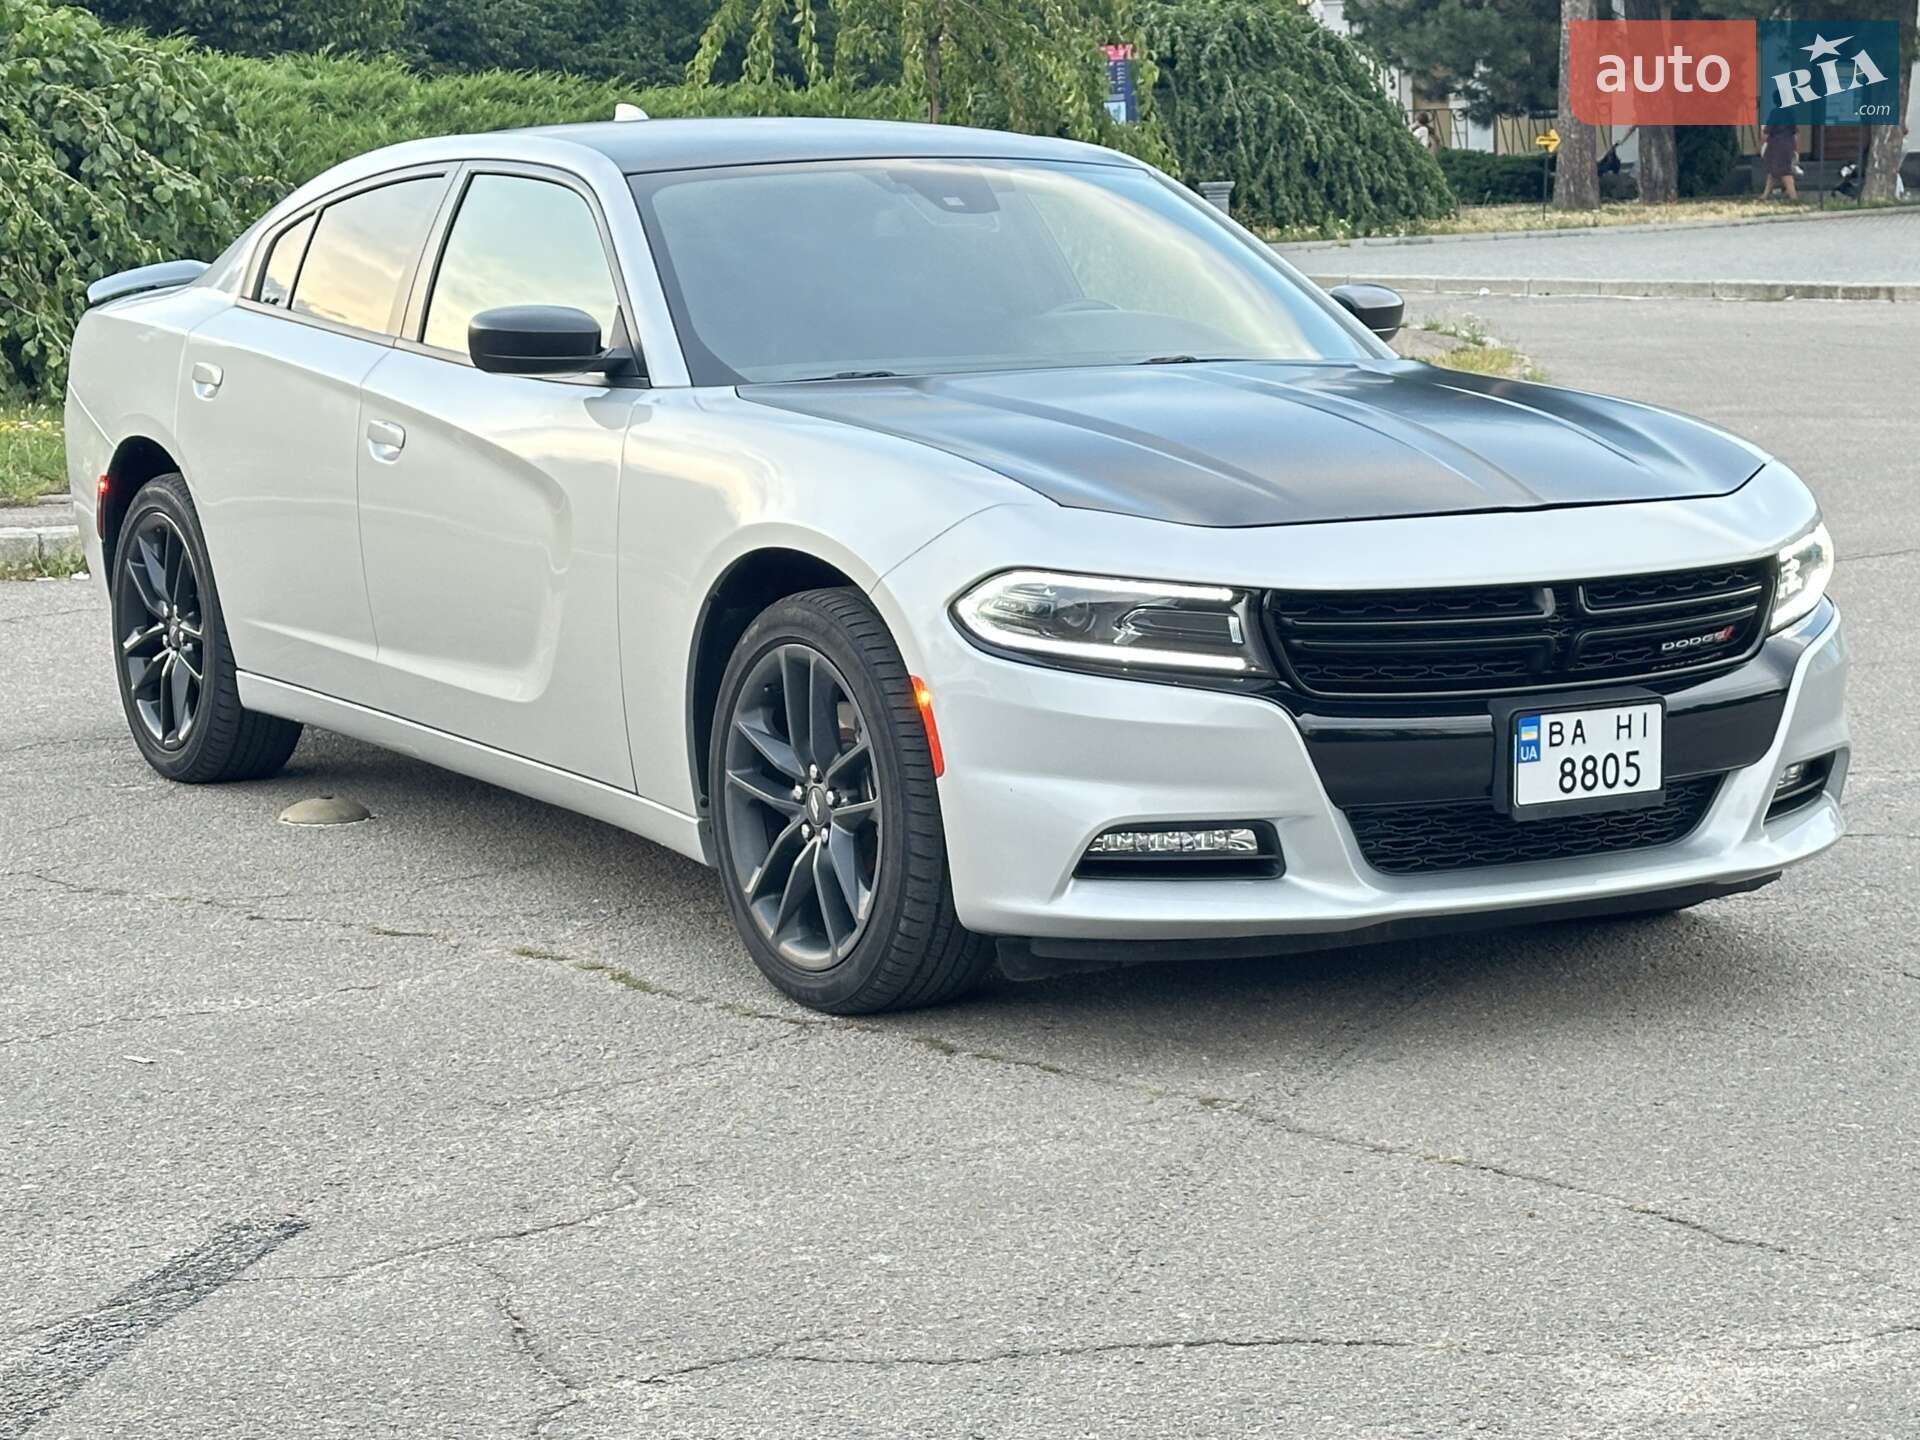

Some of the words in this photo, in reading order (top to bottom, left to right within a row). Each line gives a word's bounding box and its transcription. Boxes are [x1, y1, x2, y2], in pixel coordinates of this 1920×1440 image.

[1549, 719, 1586, 747] BA
[1616, 712, 1647, 740] HI
[1520, 745, 1538, 761] UA
[1559, 750, 1641, 794] 8805
